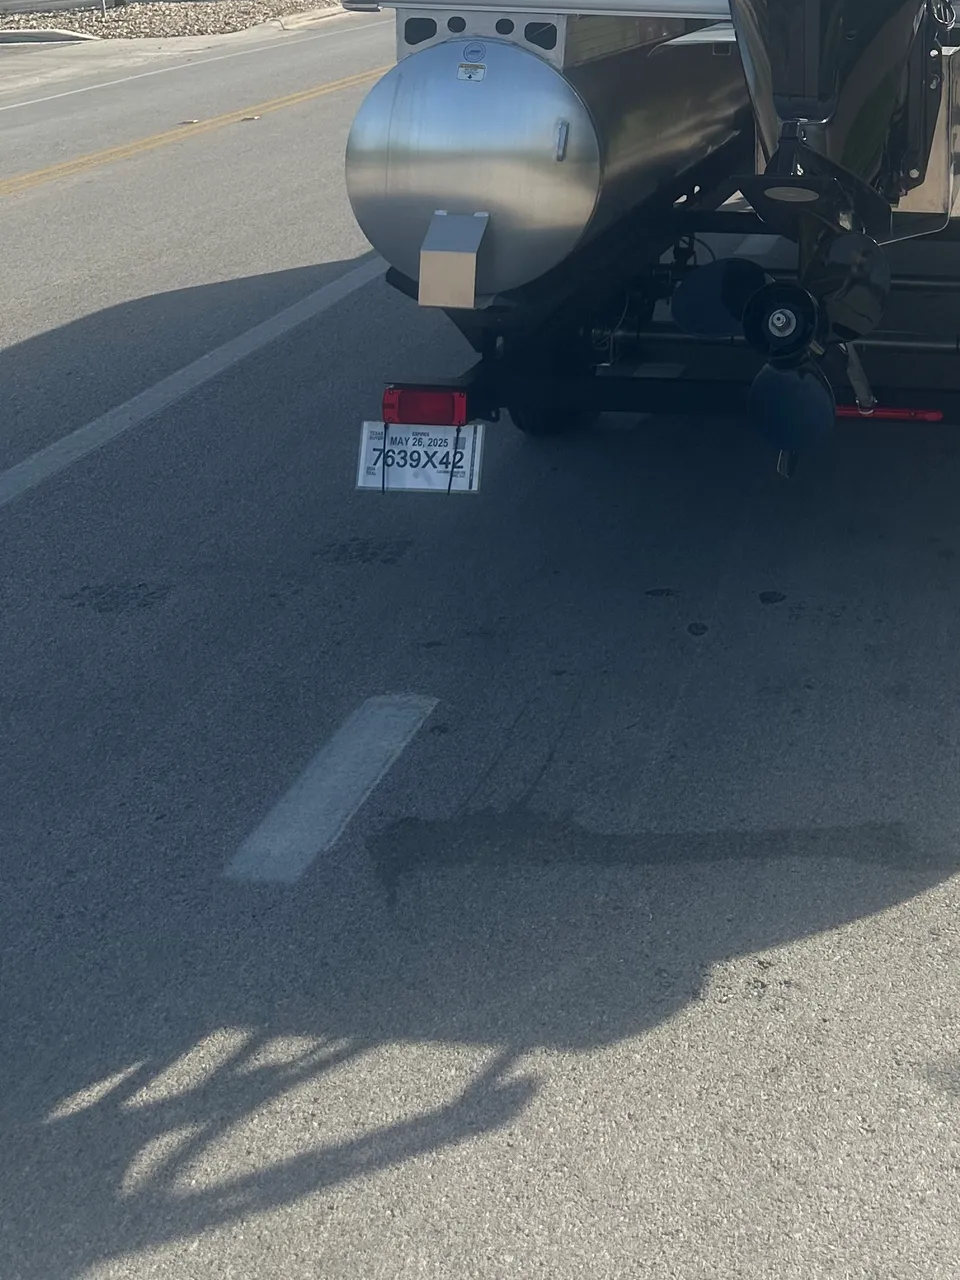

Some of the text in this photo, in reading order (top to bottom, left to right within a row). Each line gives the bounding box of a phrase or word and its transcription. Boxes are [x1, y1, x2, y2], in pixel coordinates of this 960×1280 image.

[390, 436, 449, 448] MAY 26, 2025
[372, 448, 465, 469] 7639X42
